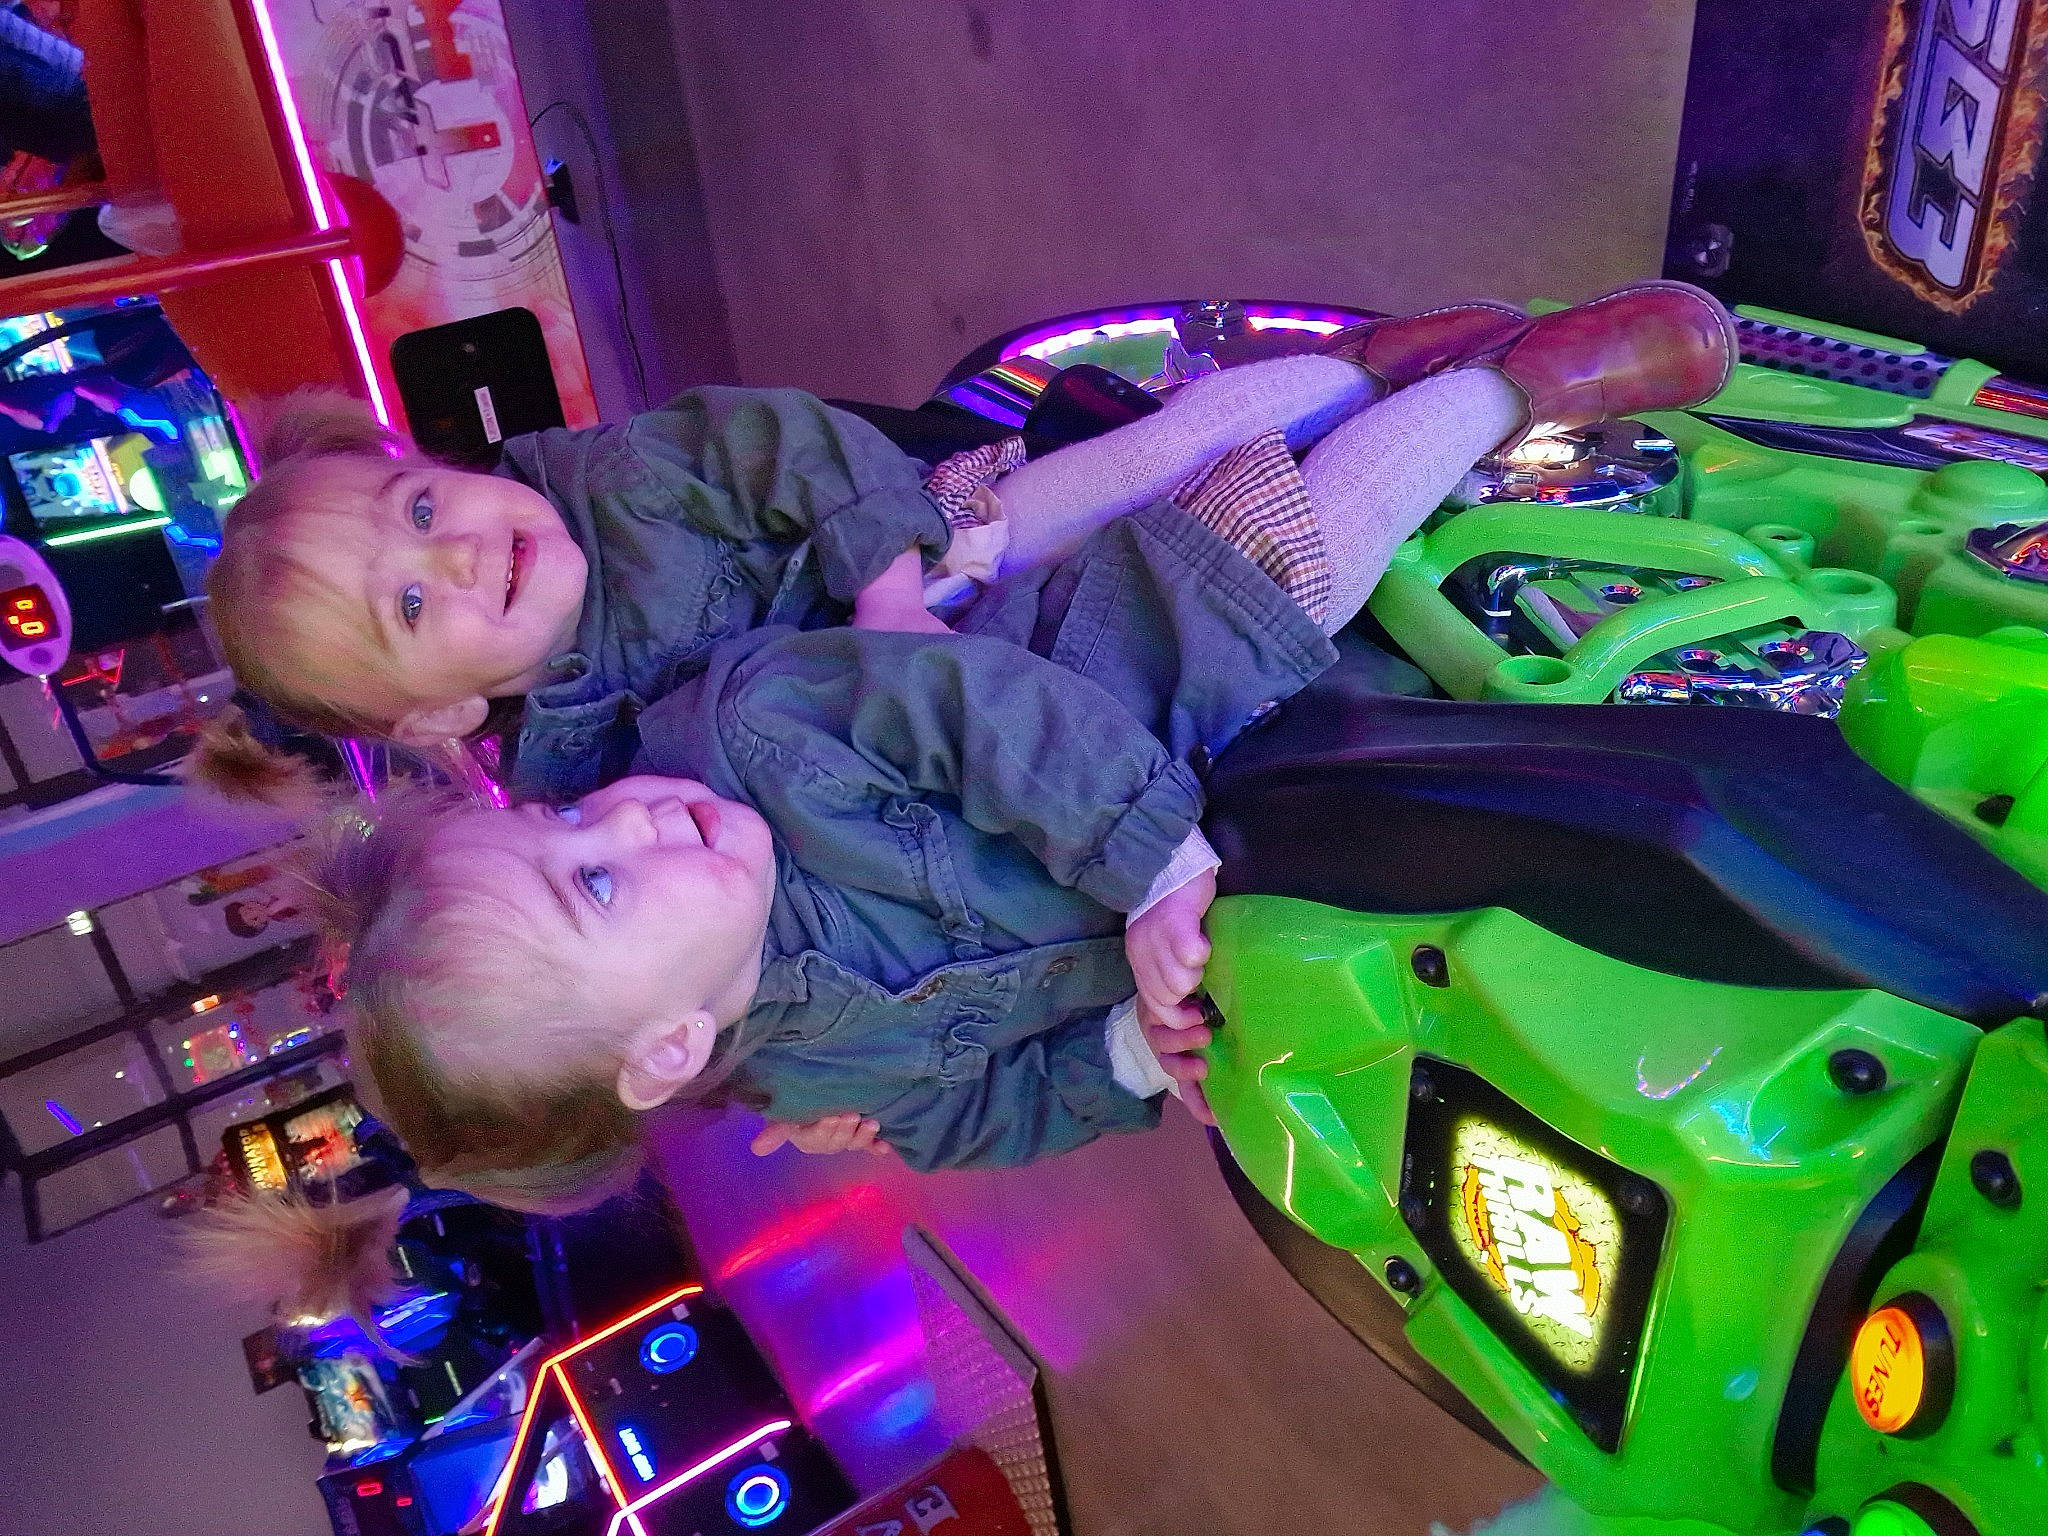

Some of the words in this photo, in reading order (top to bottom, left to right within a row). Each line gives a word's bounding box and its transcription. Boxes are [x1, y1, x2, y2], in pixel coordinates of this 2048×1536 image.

[1472, 1153, 1545, 1319] THRILLS
[1500, 1147, 1593, 1338] RAW
[1865, 1325, 1901, 1418] TUNES
